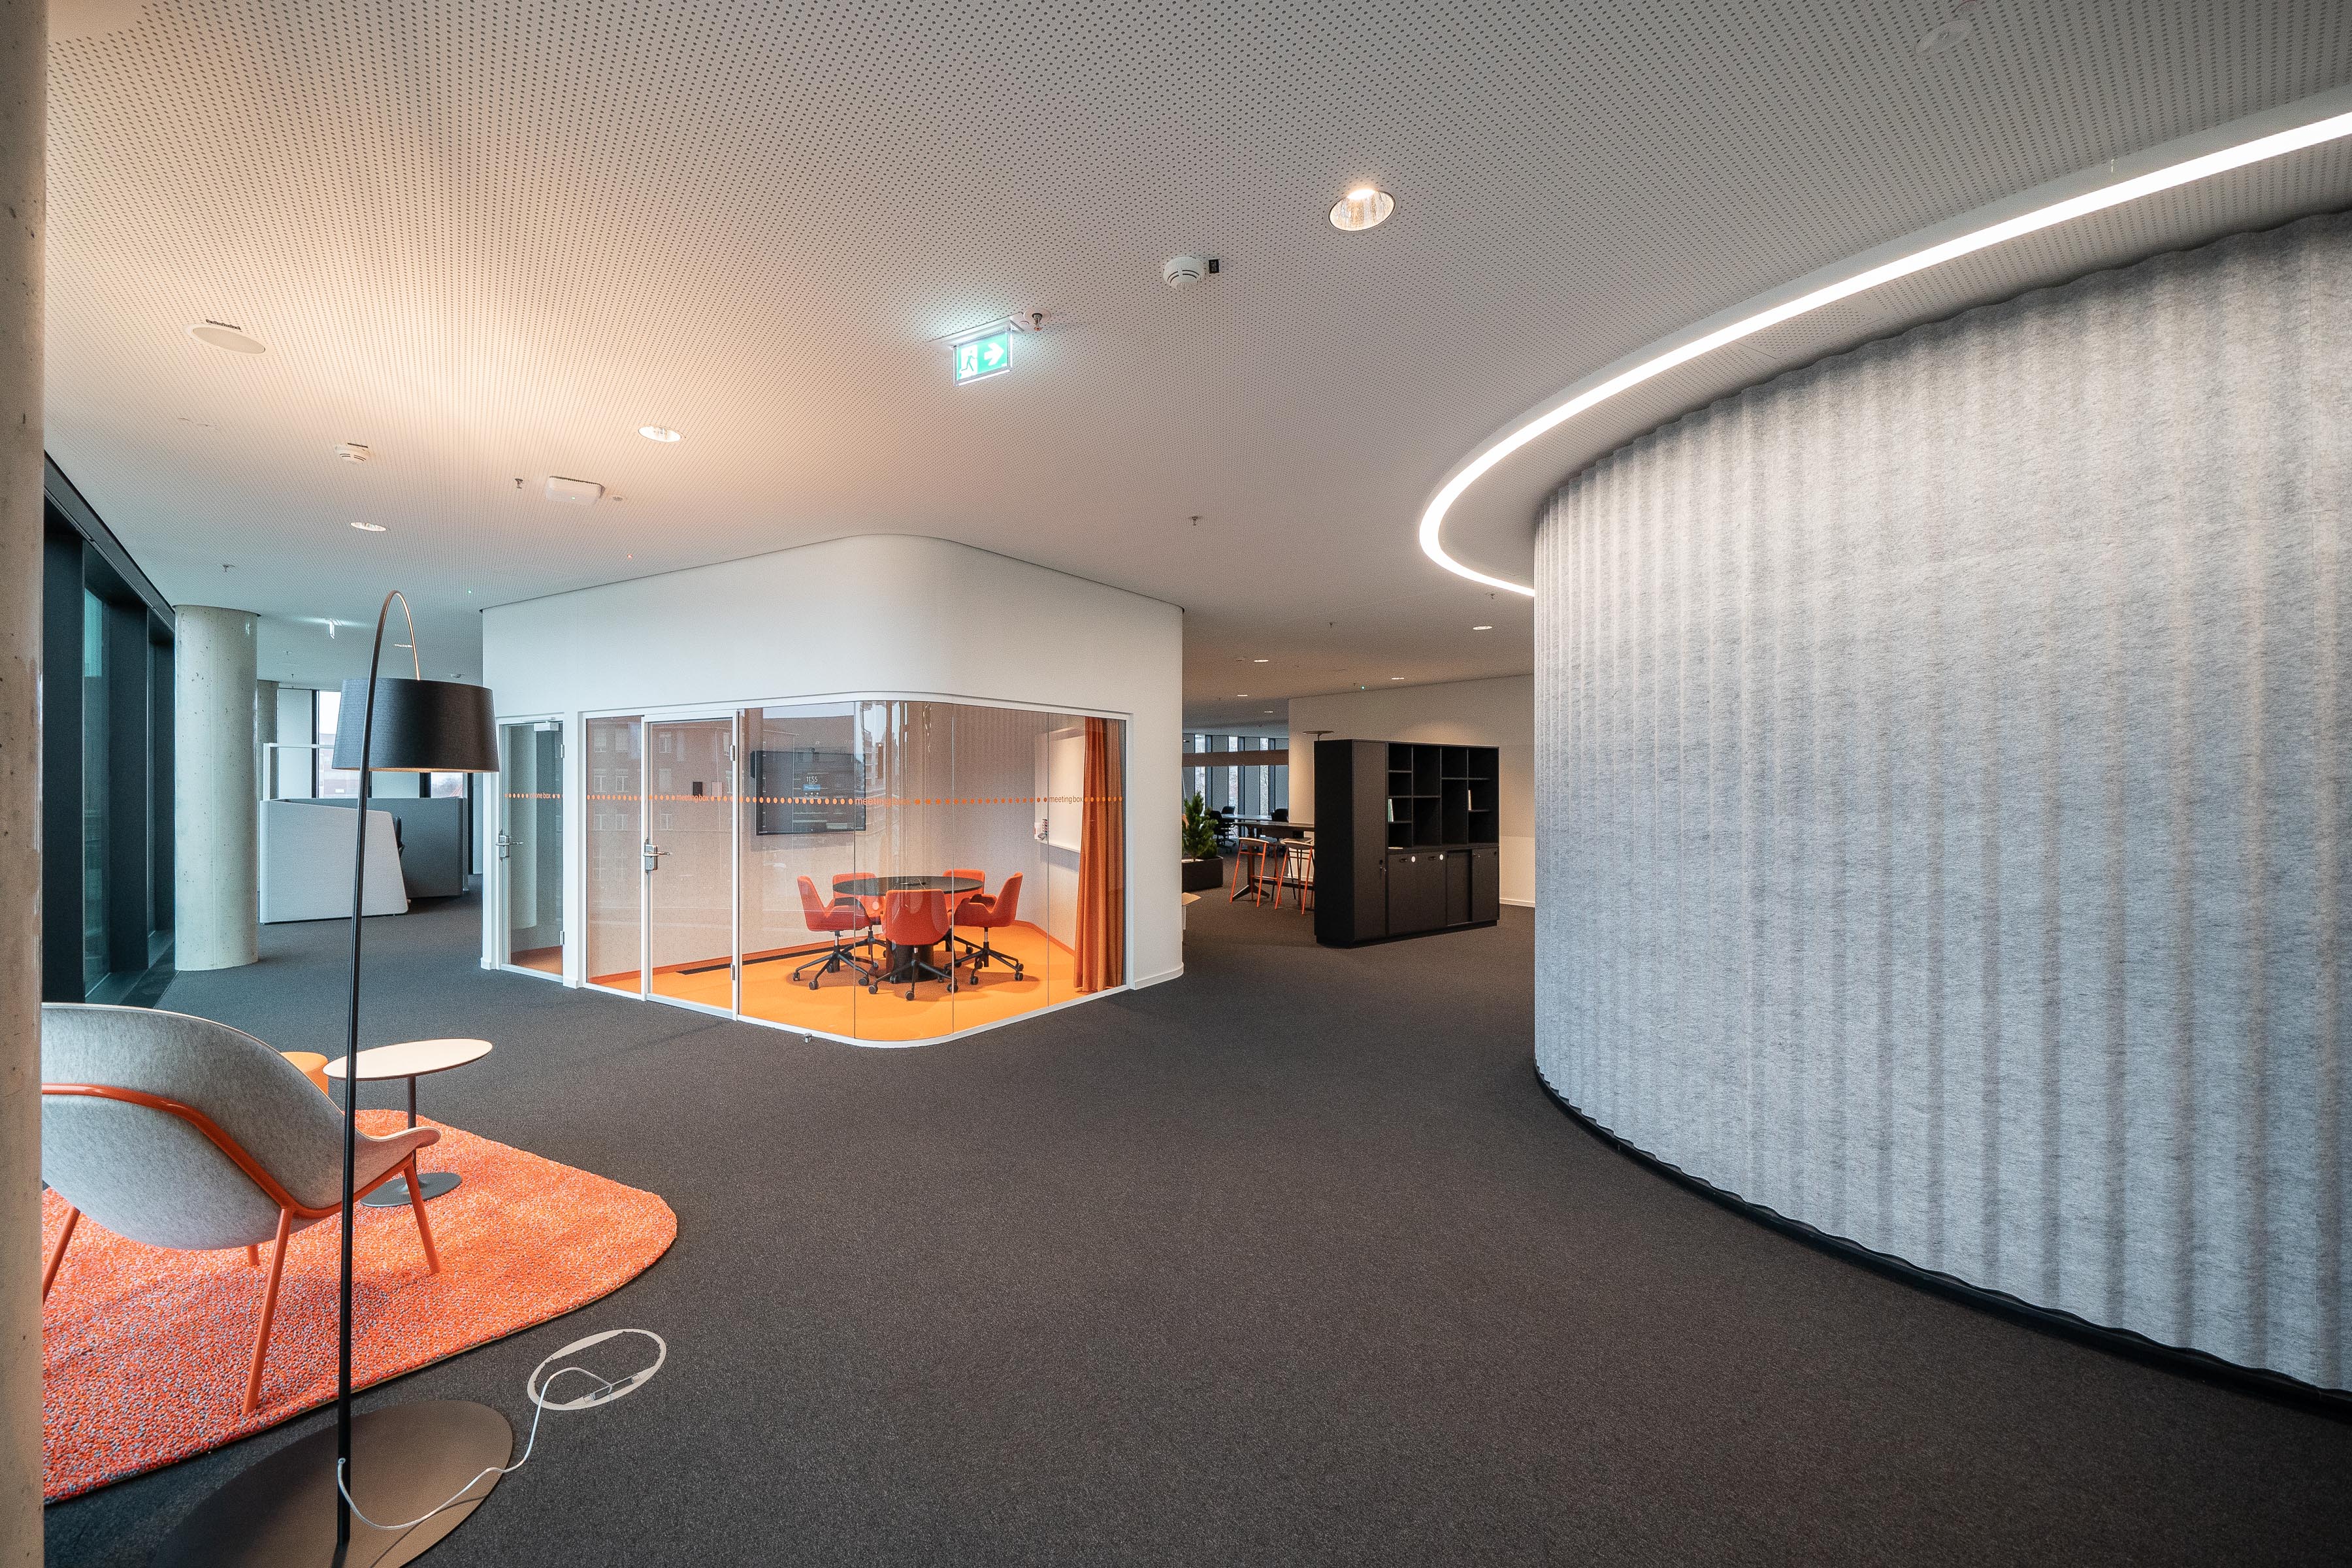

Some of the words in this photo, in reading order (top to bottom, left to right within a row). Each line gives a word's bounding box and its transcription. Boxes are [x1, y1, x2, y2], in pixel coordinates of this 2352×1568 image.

[676, 794, 698, 803] meeting
[855, 797, 892, 808] meeting
[1049, 796, 1072, 804] meeting
